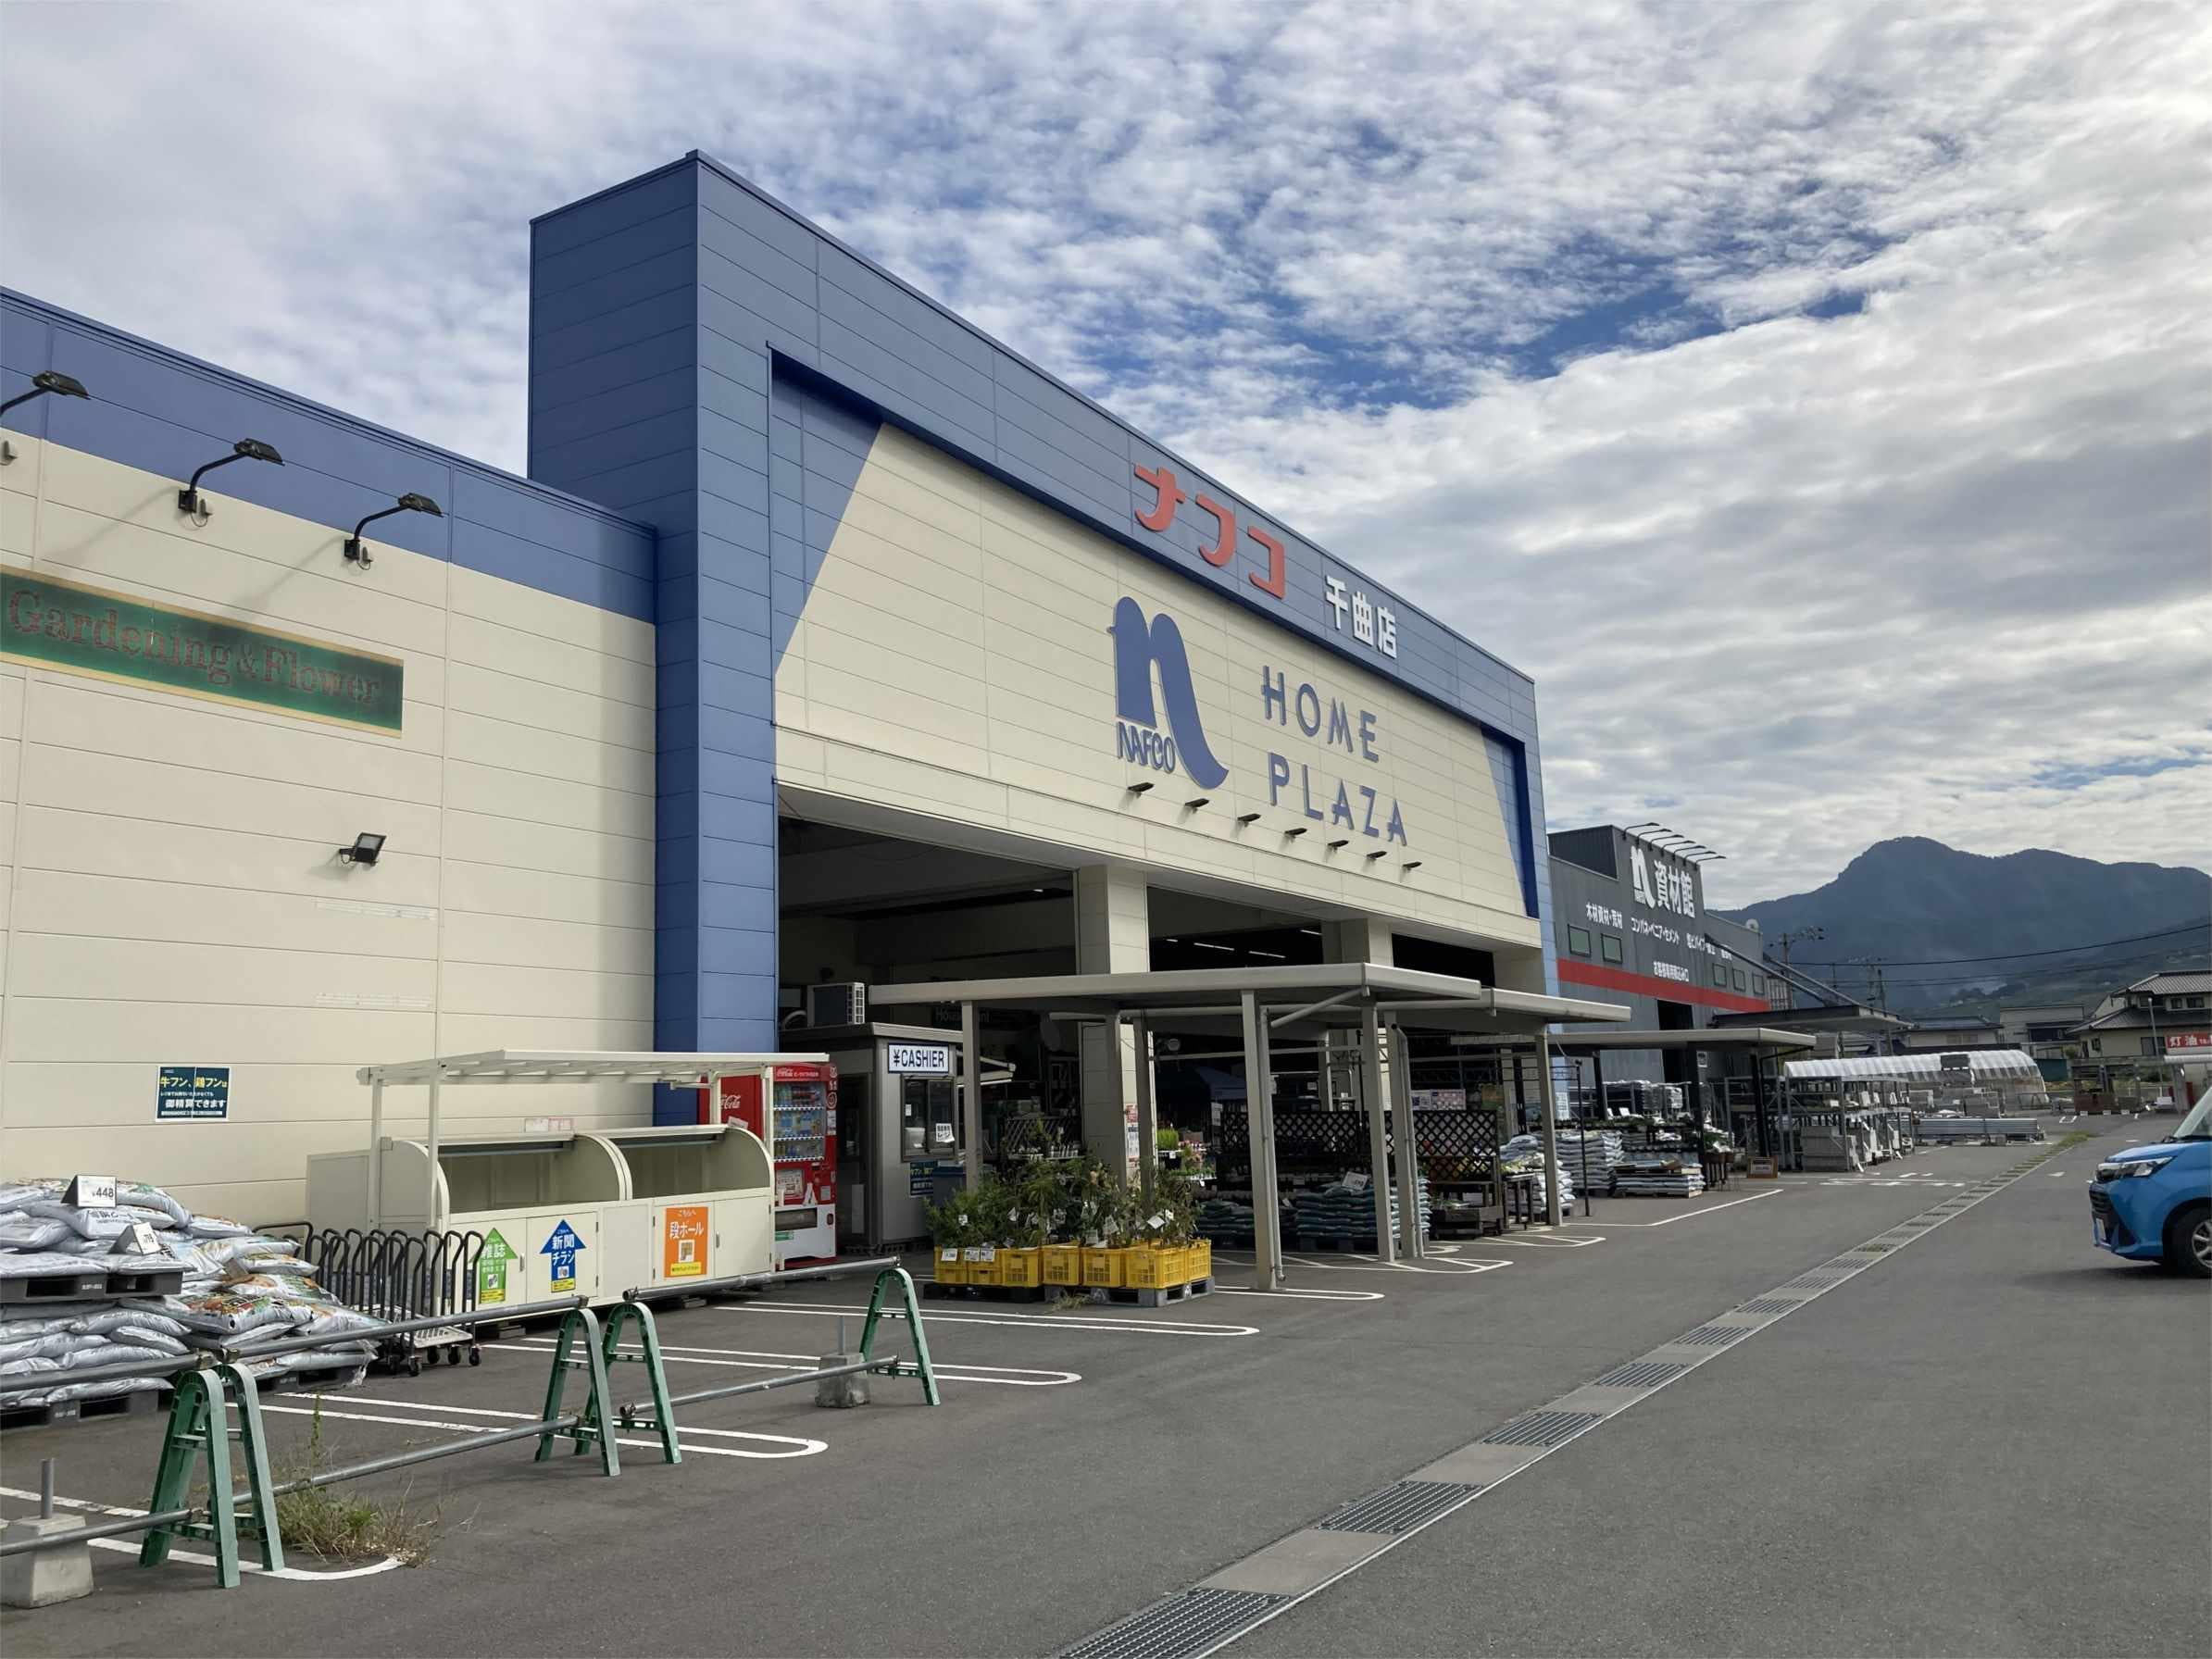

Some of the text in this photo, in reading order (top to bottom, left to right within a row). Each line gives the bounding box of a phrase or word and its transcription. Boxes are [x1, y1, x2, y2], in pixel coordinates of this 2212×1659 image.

[1134, 464, 1286, 599] ナフコ
[8, 590, 231, 686] Gardening
[1325, 575, 1397, 658] 千曲店
[1117, 721, 1176, 774] NAFCO
[1261, 666, 1380, 763] HOME
[1268, 752, 1407, 846] PLAZA
[1654, 859, 1696, 918] 資材館
[552, 1233, 575, 1250] 新聞
[552, 1250, 575, 1266] チラシ
[670, 1221, 705, 1240] 段ボール
